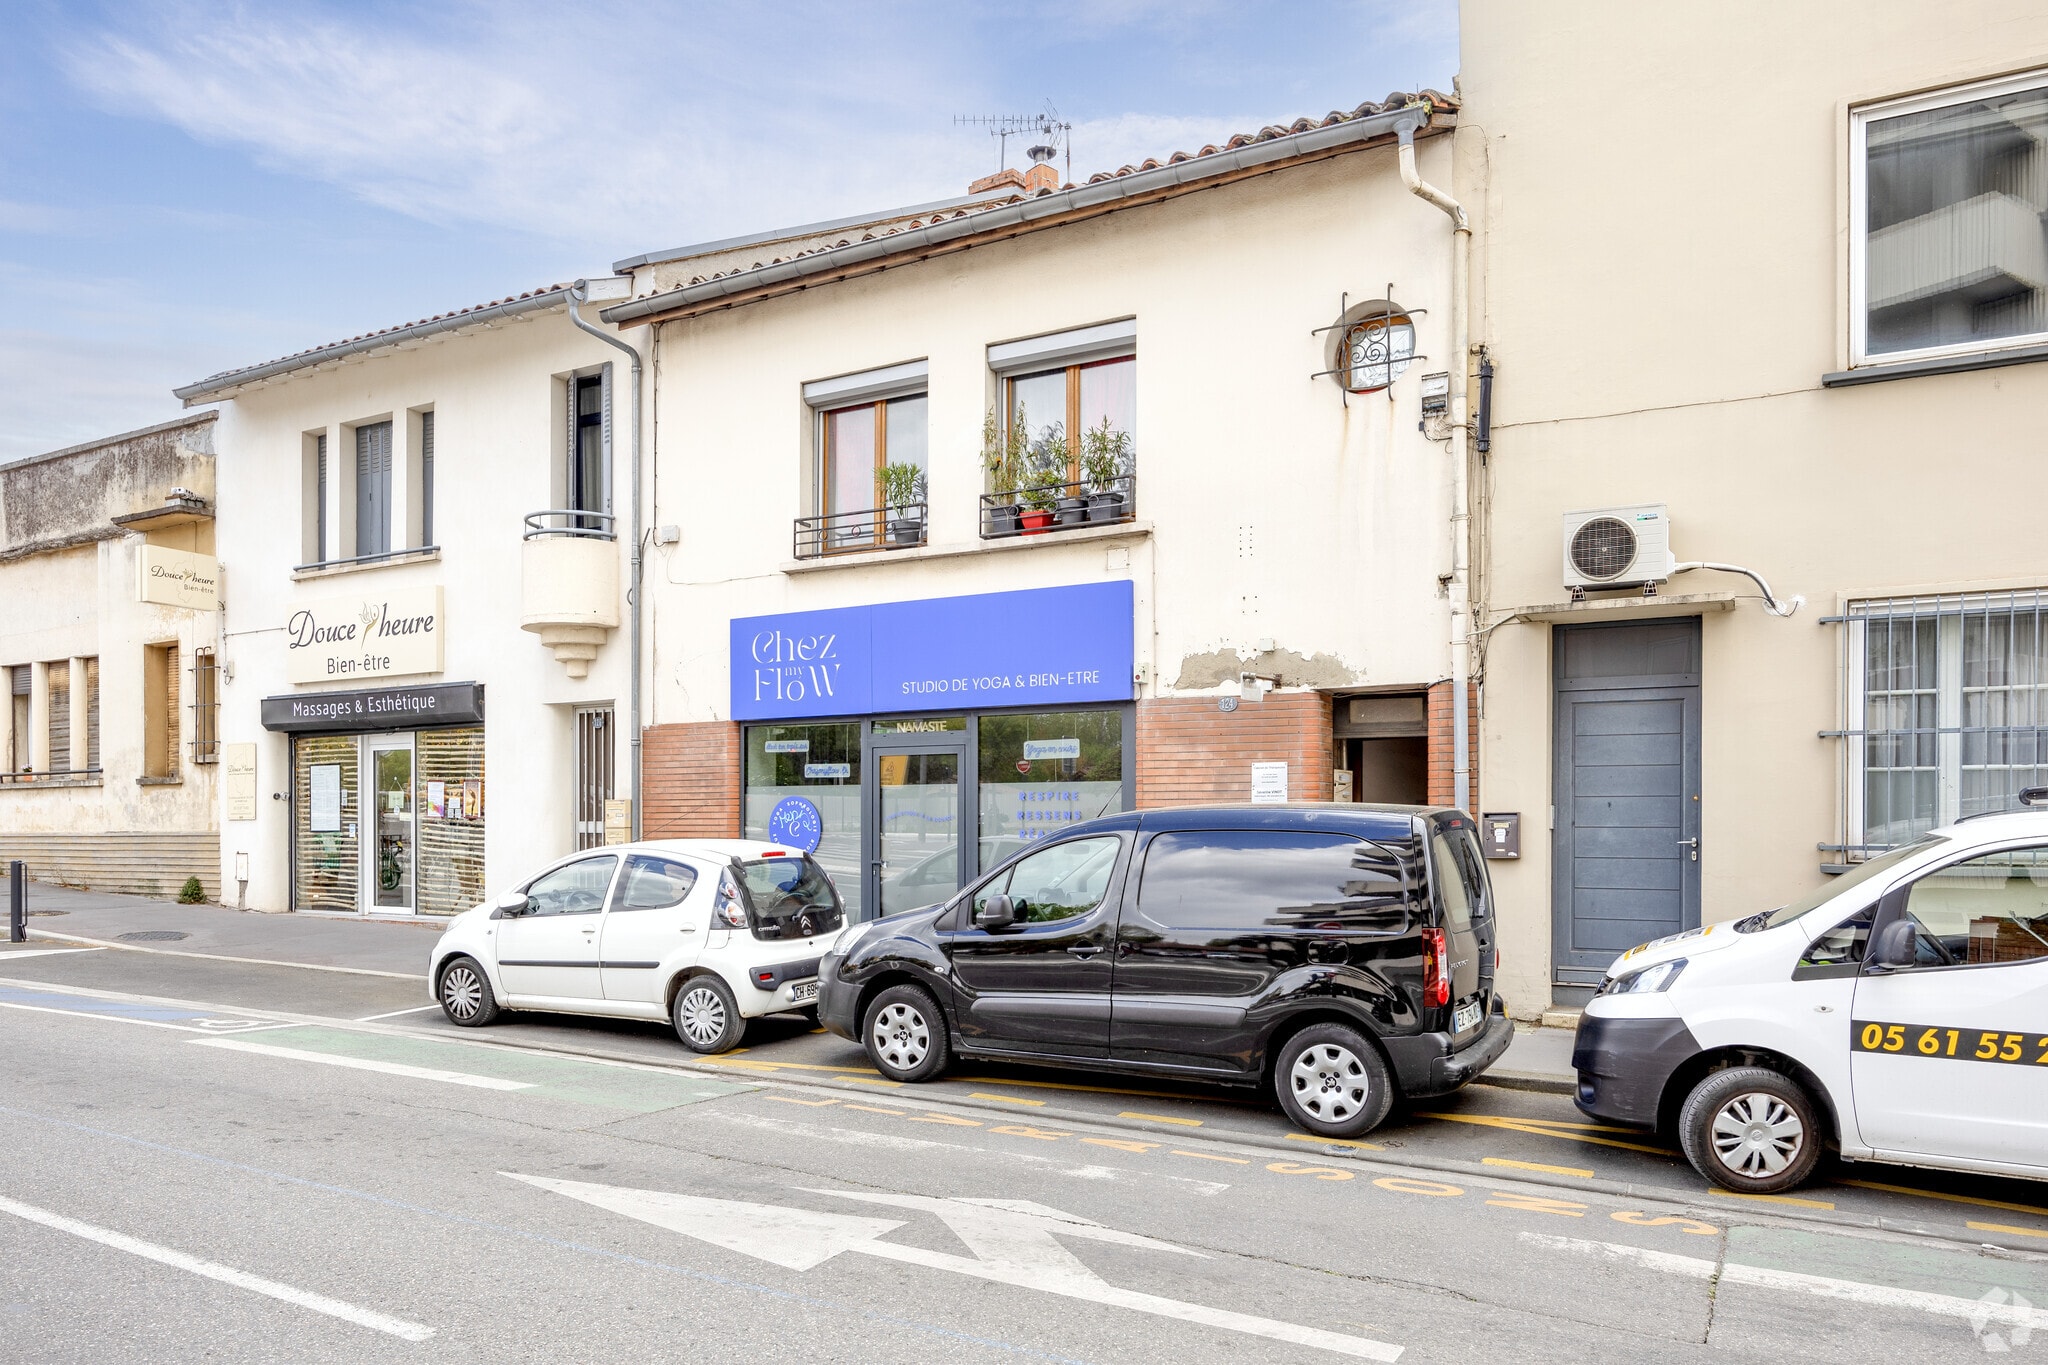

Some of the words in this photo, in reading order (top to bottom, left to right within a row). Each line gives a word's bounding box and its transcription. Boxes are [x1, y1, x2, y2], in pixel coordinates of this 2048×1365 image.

[150, 565, 184, 580] Douce
[192, 572, 215, 586] heure
[183, 584, 215, 594] Bien-être
[288, 610, 356, 649] Douce
[378, 602, 434, 637] heure
[752, 630, 837, 664] Chez
[327, 653, 390, 674] Bien-être
[785, 665, 805, 680] my
[902, 680, 949, 695] STUDIO
[952, 678, 969, 692] DE
[972, 676, 1011, 690] YOGA
[1014, 674, 1025, 688] &
[1029, 670, 1100, 688] BIEN-ETRE
[293, 701, 351, 719] Massages
[355, 699, 363, 714] &
[367, 693, 436, 713] Esthétique
[896, 720, 948, 733] NAMASTE
[1018, 791, 1079, 801] RESPIRE
[772, 807, 783, 826] YOGA
[786, 800, 818, 833] SOPHROLOGIE
[1017, 810, 1082, 820] RESSENS
[1018, 826, 1051, 839] RÉA
[1861, 1024, 1906, 1052] 05
[1918, 1028, 1959, 1056] 61
[1975, 1033, 2023, 1061] 55
[764, 1096, 1720, 1236] LIVRAISONS
